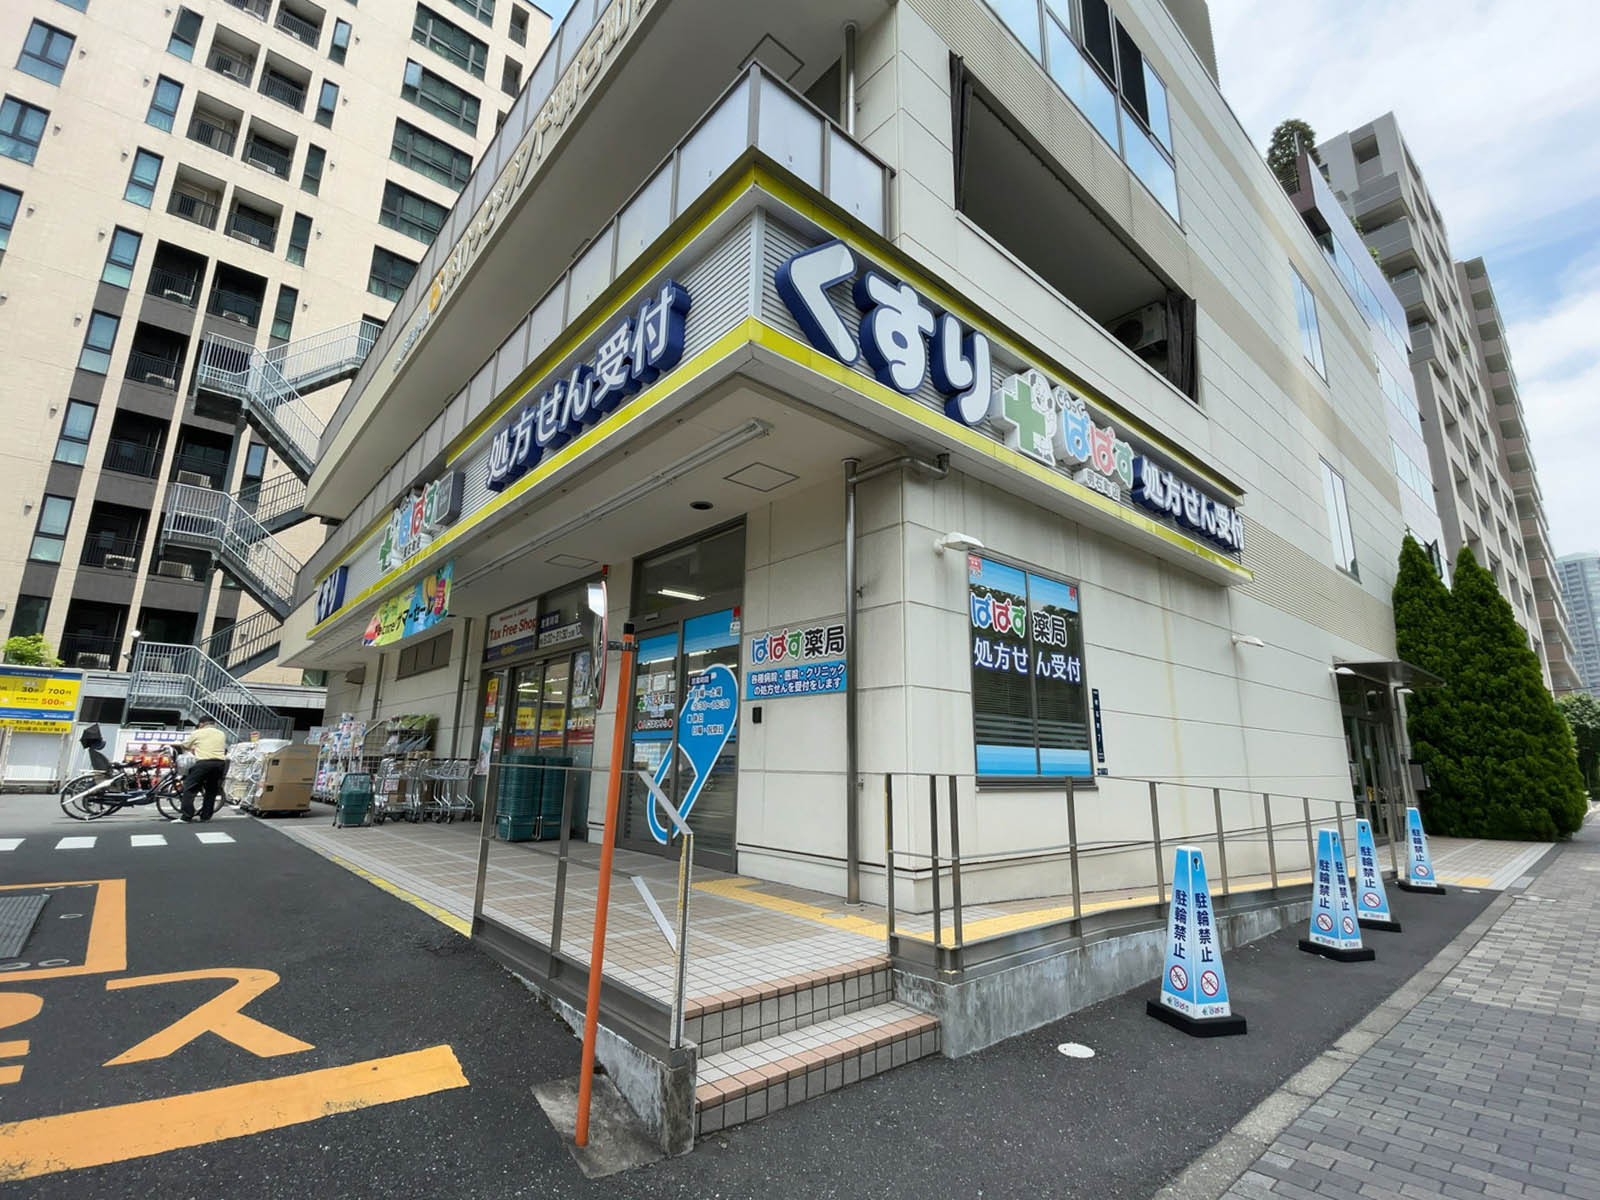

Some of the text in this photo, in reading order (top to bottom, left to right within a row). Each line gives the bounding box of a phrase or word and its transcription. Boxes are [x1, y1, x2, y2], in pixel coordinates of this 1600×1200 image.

[782, 240, 993, 426] くすり
[488, 285, 675, 482] 処方せん受付
[1064, 408, 1134, 489] ぱぱす
[1140, 456, 1245, 551] 処方せん受付
[489, 617, 537, 641] Tax Free Shop
[751, 624, 846, 664] ぱぱす薬局
[970, 591, 1067, 648] ぱぱす薬局
[974, 638, 1081, 682] 処方せん受付
[1360, 846, 1377, 889] 駐輪禁止
[1411, 828, 1425, 862] 駐輪禁止
[1318, 859, 1330, 910] 駐輪禁止
[1335, 861, 1350, 911] 駐輪禁止
[1173, 889, 1188, 960] 駐輪禁止
[1194, 892, 1214, 963] 駐輪禁止
[102, 967, 315, 1066] ス
